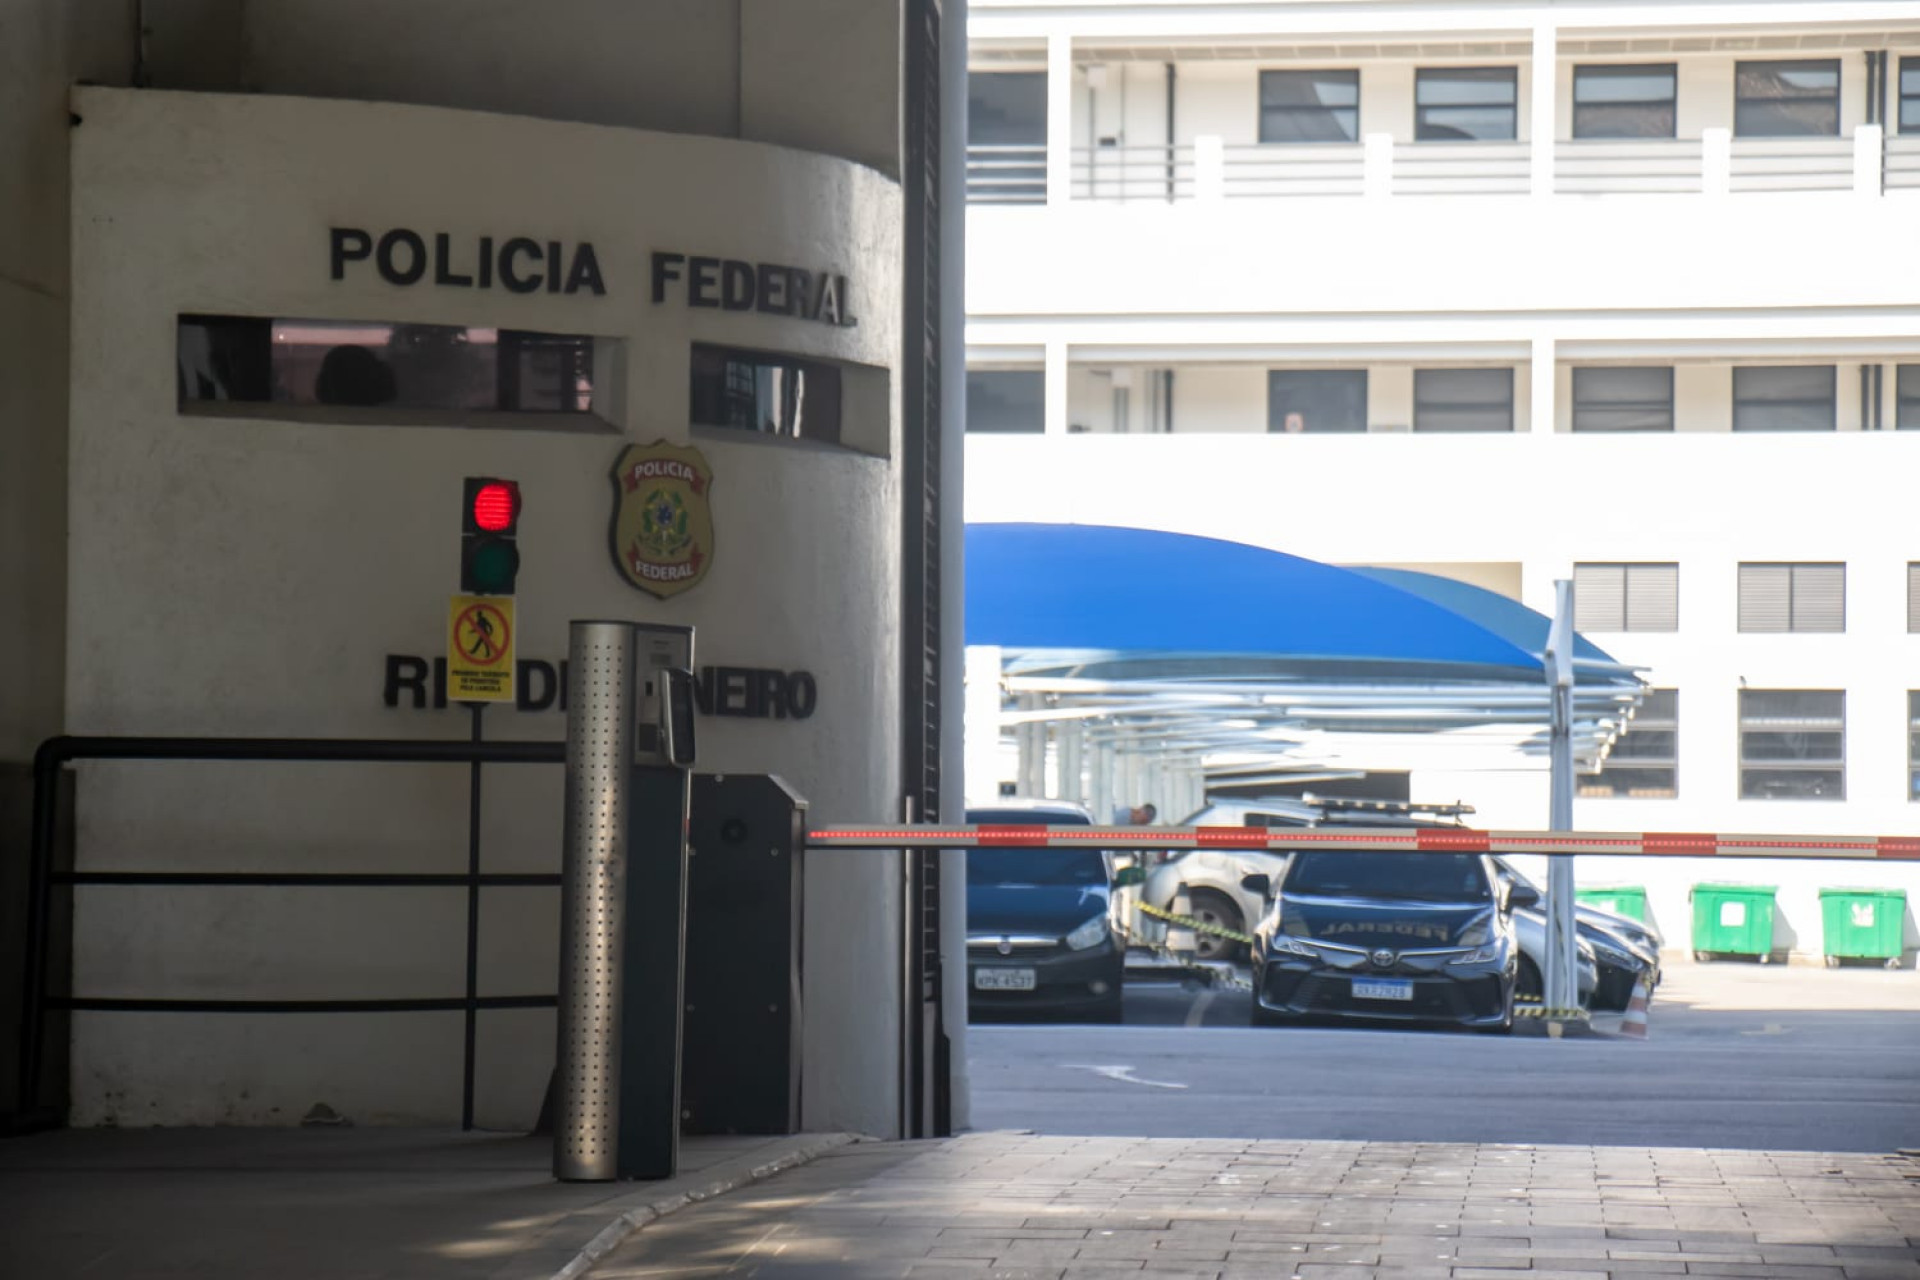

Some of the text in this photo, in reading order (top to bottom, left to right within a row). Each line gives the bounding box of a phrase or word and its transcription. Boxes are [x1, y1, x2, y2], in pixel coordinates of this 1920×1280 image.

[330, 227, 858, 327] POLICIA FEDERAL
[635, 560, 694, 580] FEDERAL
[384, 655, 447, 710] RI
[695, 665, 817, 720] NEIRO
